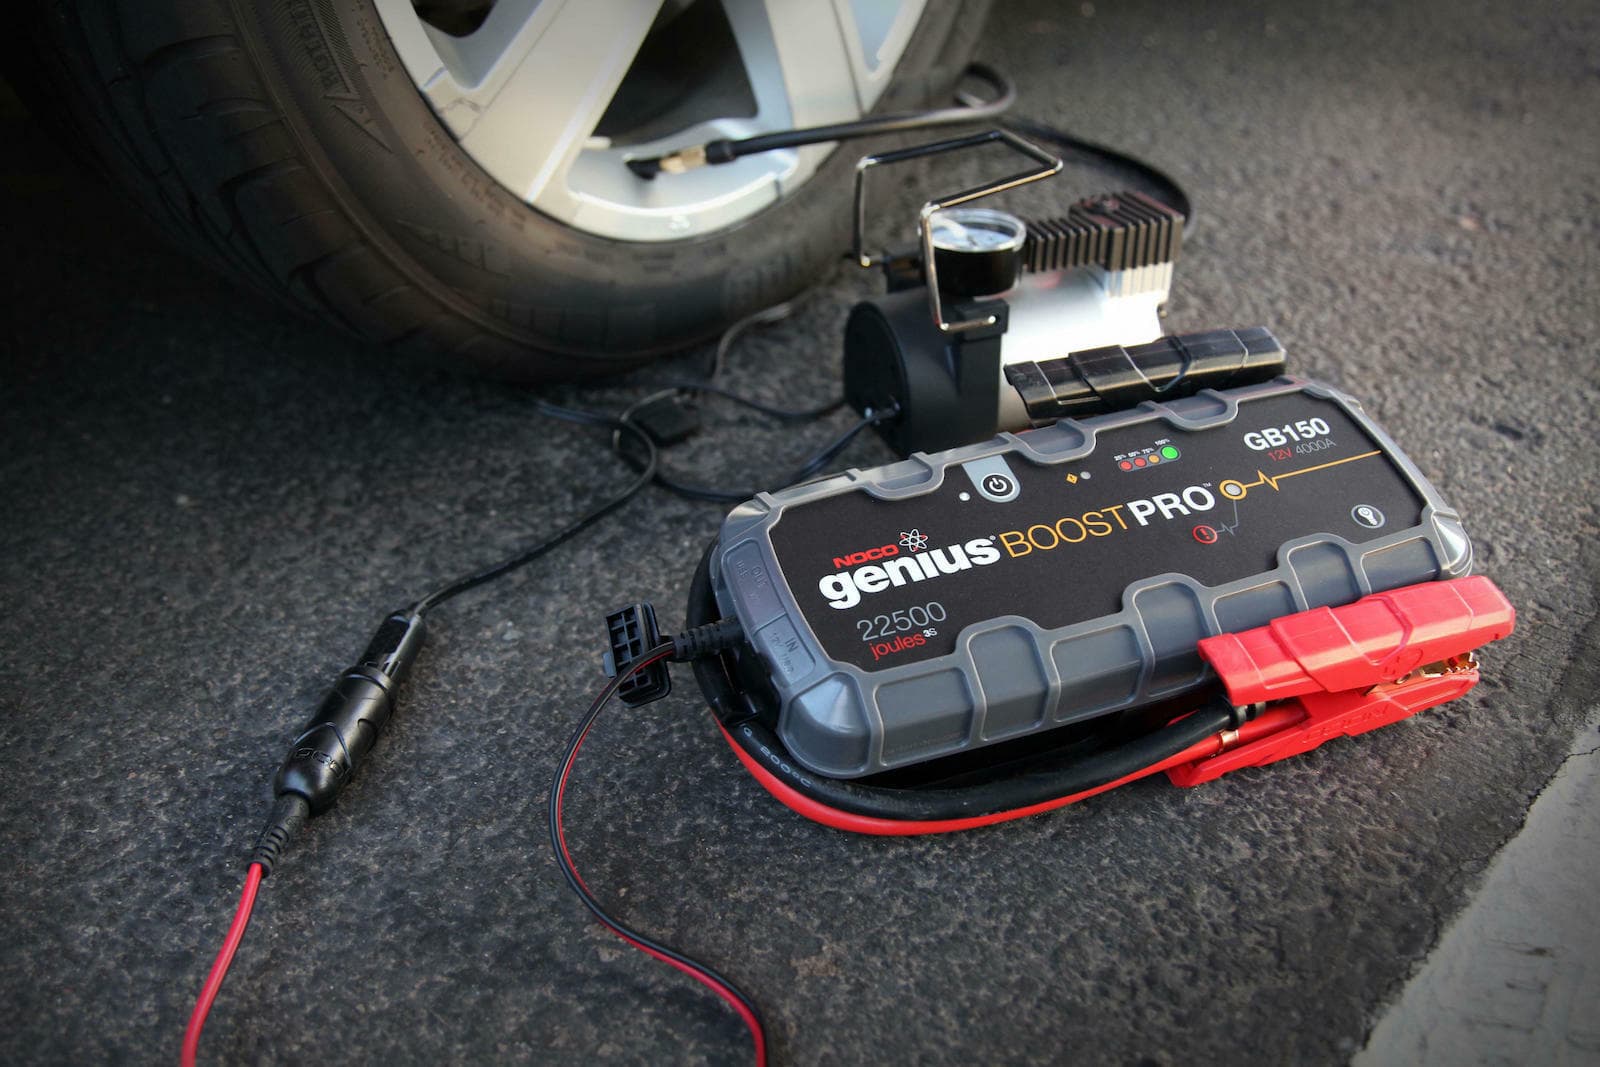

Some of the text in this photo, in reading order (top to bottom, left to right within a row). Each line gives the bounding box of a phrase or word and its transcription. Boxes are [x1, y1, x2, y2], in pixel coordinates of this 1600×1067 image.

[1243, 417, 1331, 451] GB150
[1267, 438, 1337, 462] 12V 4000A
[818, 537, 1001, 609] genius
[999, 504, 1128, 558] BOOST
[832, 544, 899, 568] NOCO
[856, 601, 947, 641] 22500
[785, 637, 799, 653] IN
